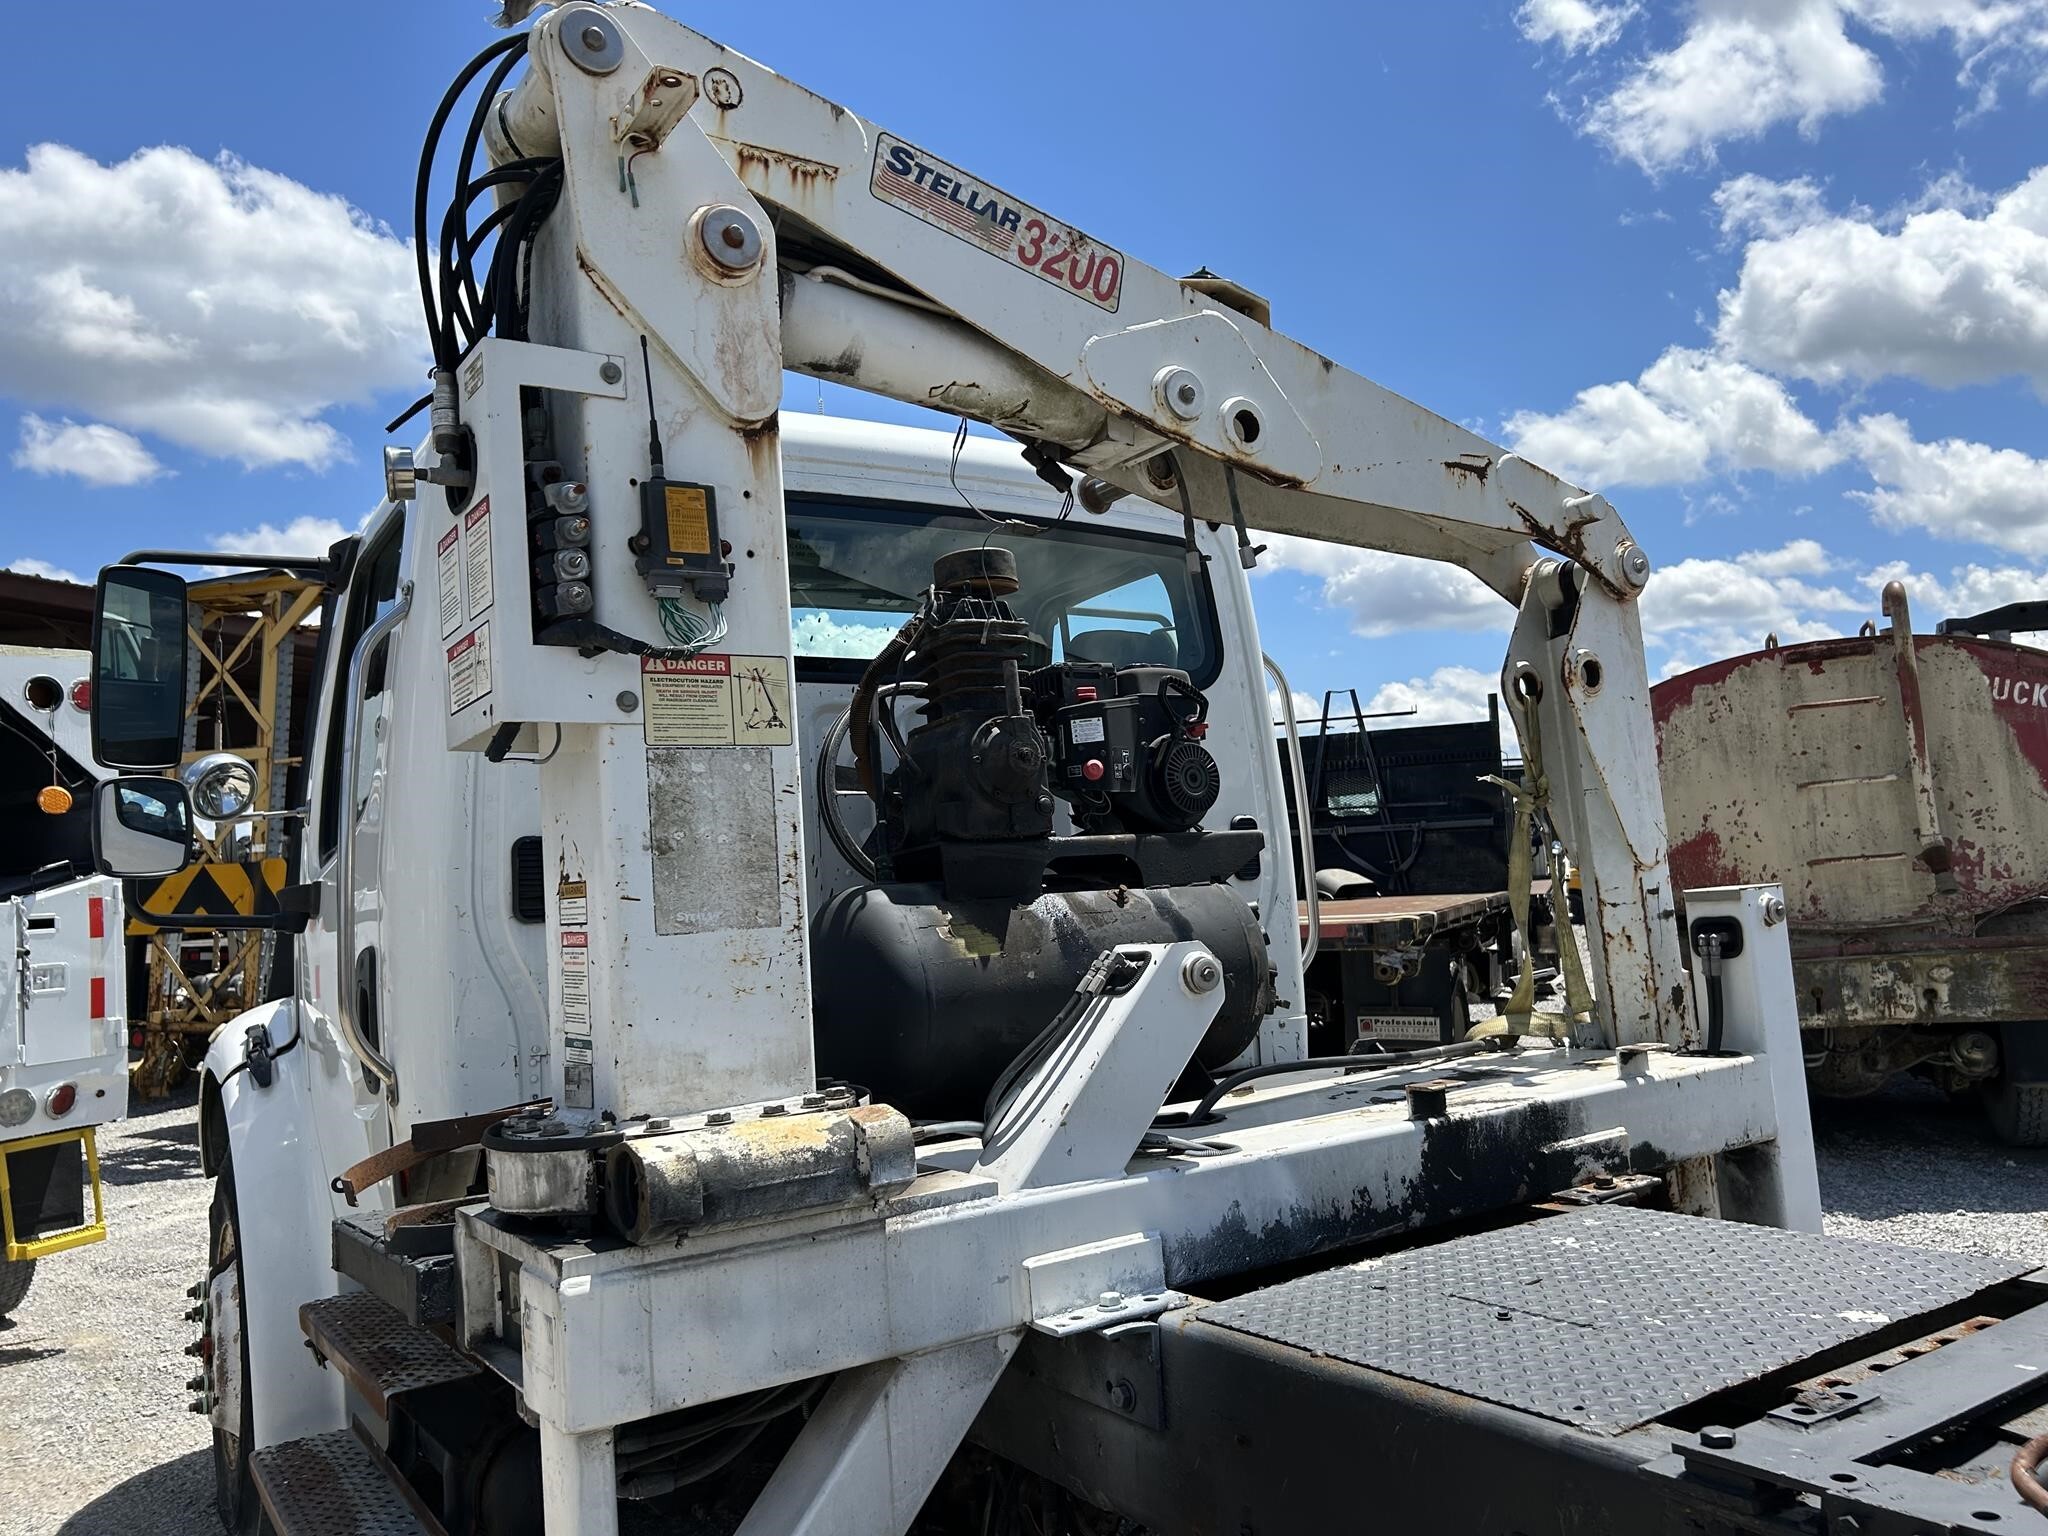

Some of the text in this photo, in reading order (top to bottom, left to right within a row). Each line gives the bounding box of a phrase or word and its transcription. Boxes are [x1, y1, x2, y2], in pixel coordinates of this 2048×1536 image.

[885, 145, 1022, 233] STELLAR
[666, 659, 726, 672] DANGER
[1983, 675, 2048, 708] UCK
[1374, 1018, 1437, 1026] Professional
